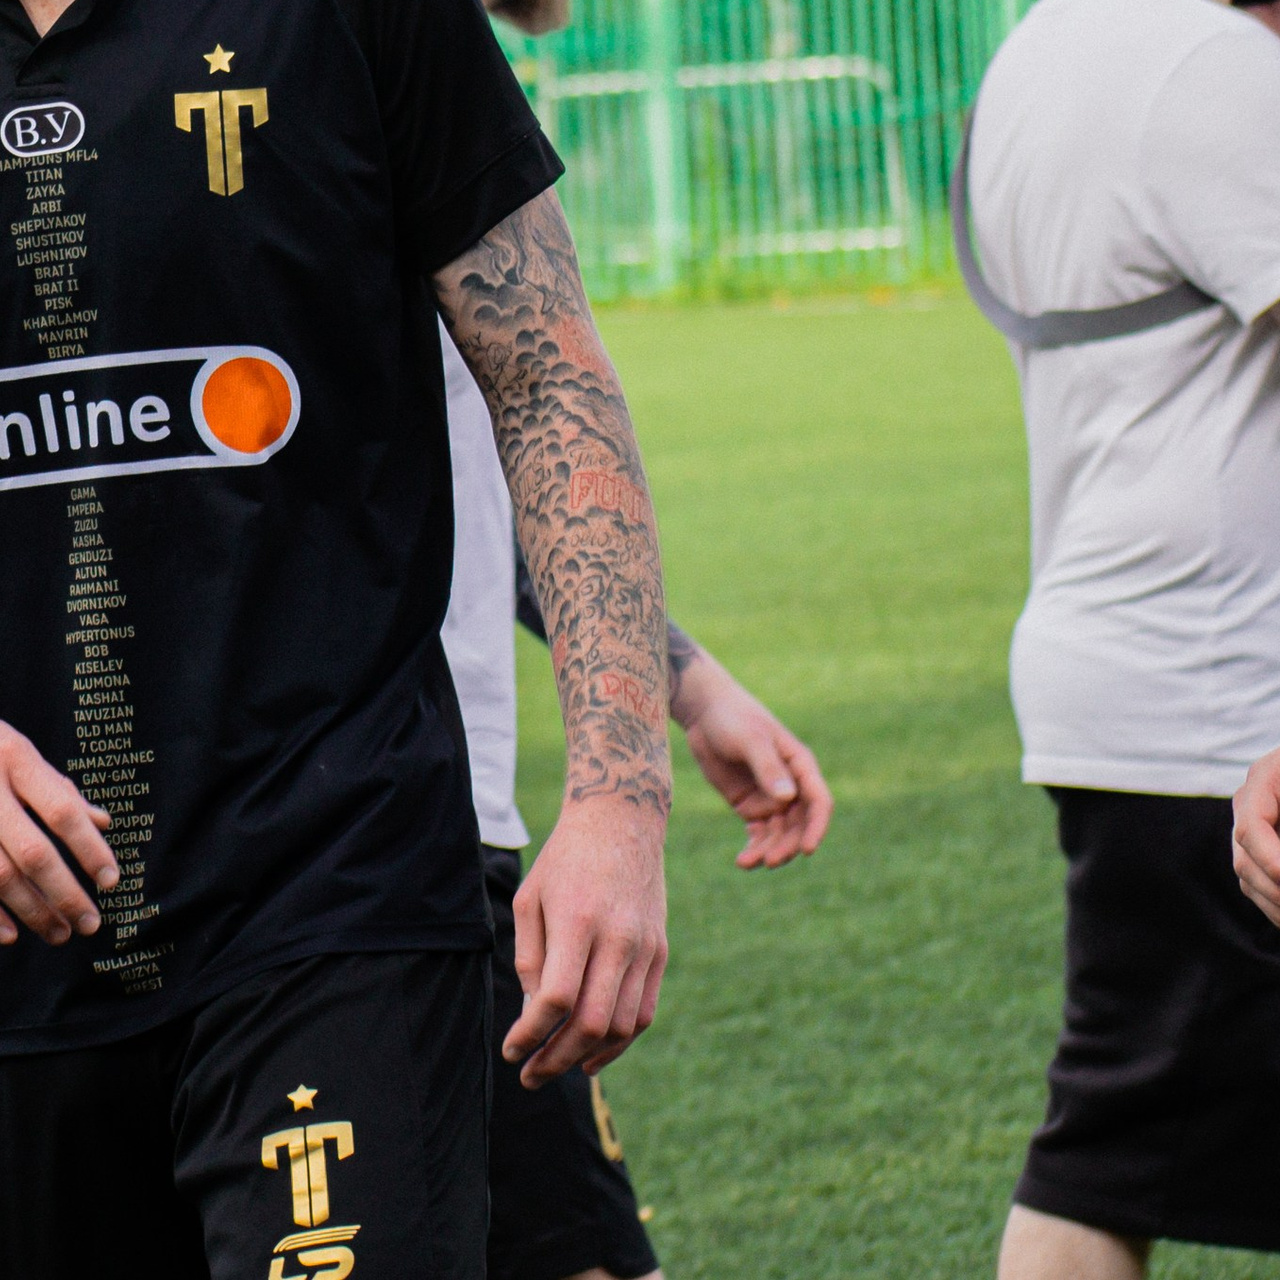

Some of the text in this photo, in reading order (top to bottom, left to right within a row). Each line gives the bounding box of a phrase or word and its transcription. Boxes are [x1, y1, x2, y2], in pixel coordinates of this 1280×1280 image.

[66, 147, 99, 164] MFL4
[25, 167, 63, 183] TITAN
[25, 184, 66, 200] ZAYKA
[31, 200, 62, 215] ARBI
[10, 213, 87, 236] SHEPLYAKOV
[15, 230, 85, 251] SHUSTIKOV
[16, 246, 88, 267] LUSHNIKOV
[34, 262, 75, 280] BRAT I
[34, 278, 80, 296] BRAT II
[44, 296, 74, 311] PISK
[23, 309, 99, 330] KHARLAMOV
[37, 326, 89, 345] MAVRIN
[47, 343, 86, 359] BIRYA
[70, 486, 97, 500] GAMA
[66, 501, 105, 518] IMPERA
[74, 518, 99, 533] ZUZU
[72, 533, 105, 549] KASHA
[68, 548, 115, 566] GENDUZI
[74, 565, 108, 581] ALTUN
[69, 579, 120, 597] RAHMANI
[66, 594, 127, 614] DVORNIKOV
[79, 612, 110, 627] VAGA
[65, 625, 136, 645] HYPERTONUS
[84, 644, 110, 658] BOB
[74, 659, 124, 675] KISELEV
[72, 673, 131, 691] ALUMONA
[78, 689, 125, 706] KASHAI
[73, 704, 134, 723] TAVUZIAN
[76, 720, 133, 738] OLD MAN
[89, 737, 133, 753] COACH
[66, 749, 155, 772] SHAMAZVANEC
[82, 767, 137, 786] GAV-GAV
[98, 800, 135, 814] AZAN
[104, 829, 153, 846] GOGRAD
